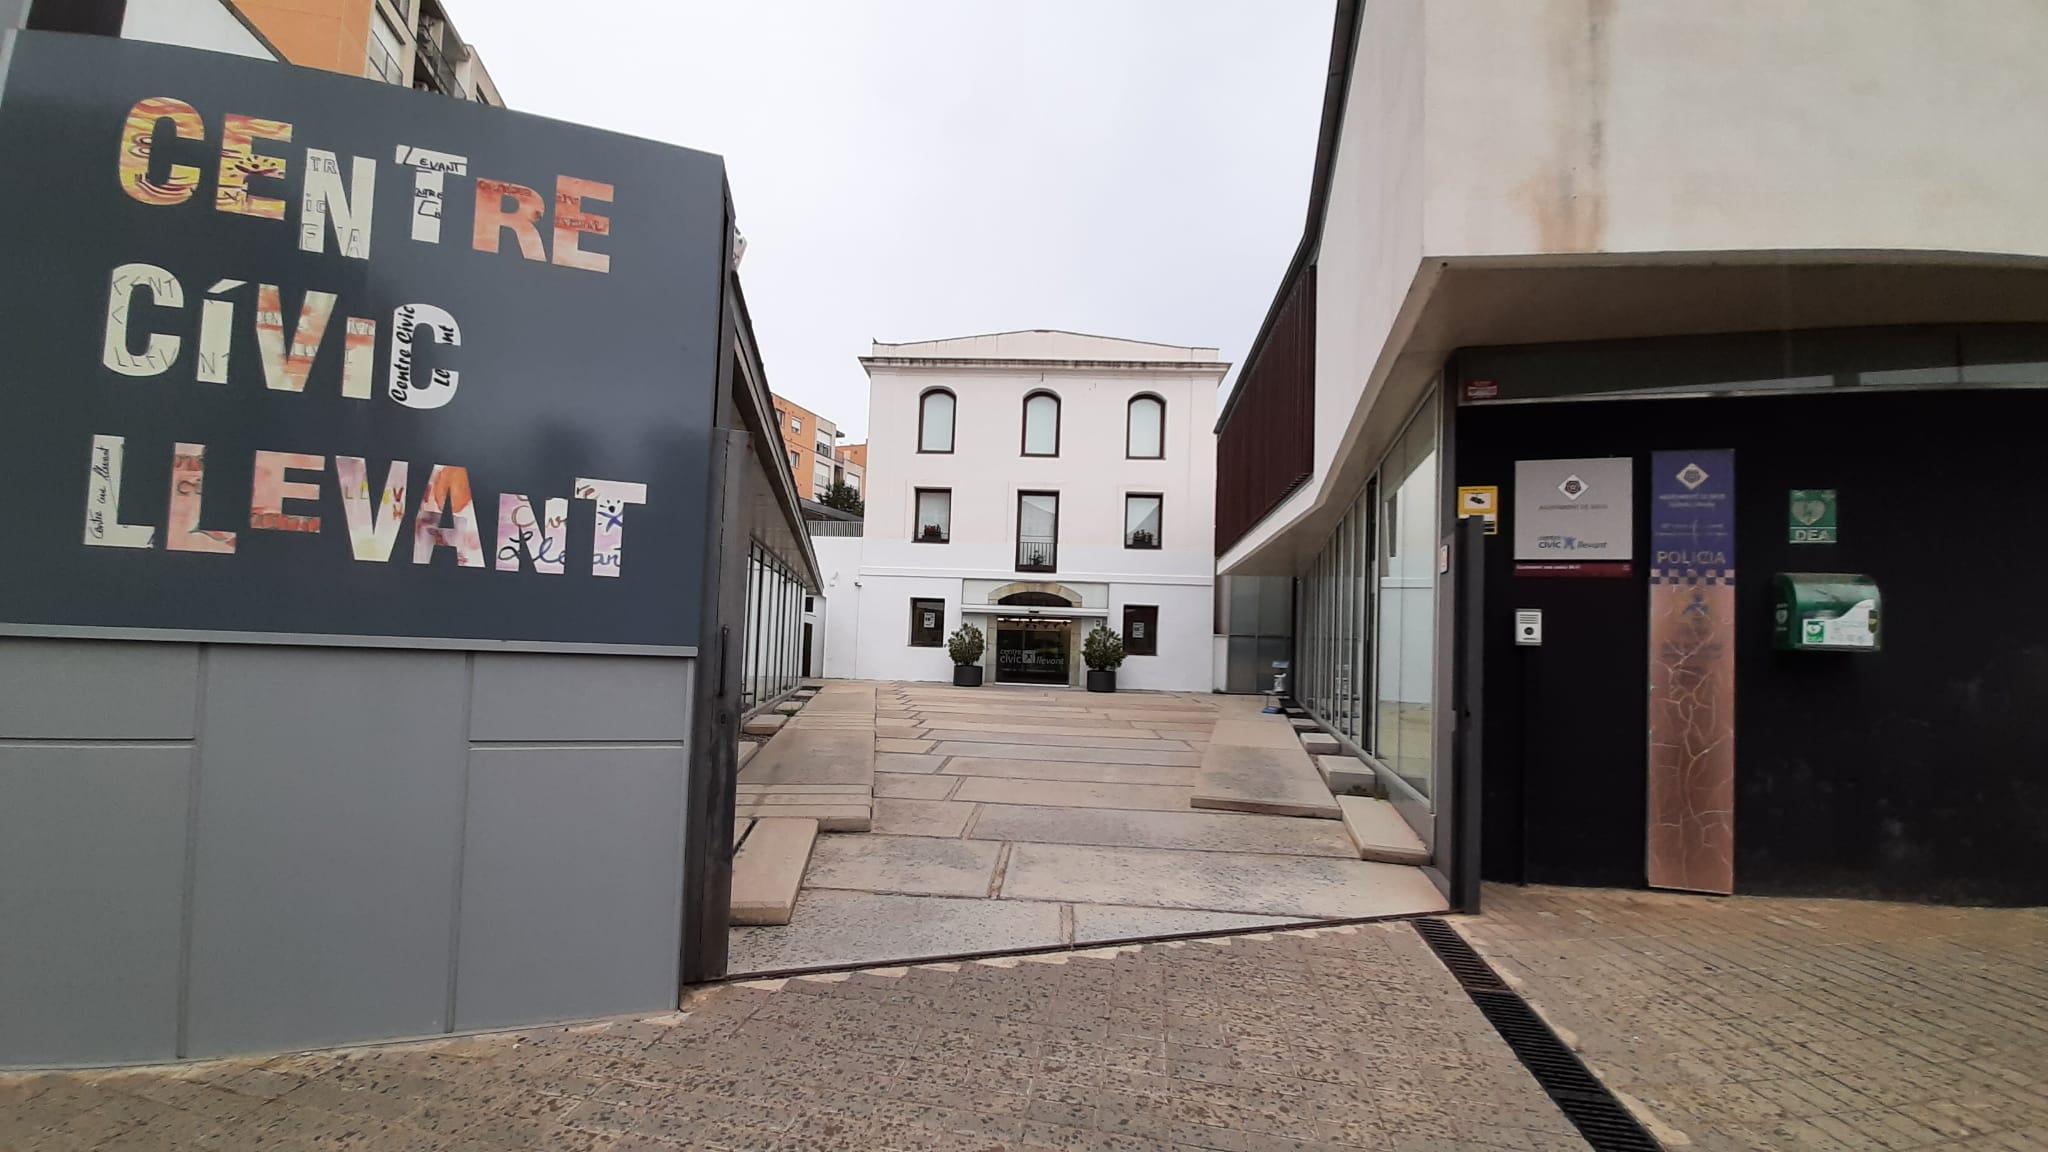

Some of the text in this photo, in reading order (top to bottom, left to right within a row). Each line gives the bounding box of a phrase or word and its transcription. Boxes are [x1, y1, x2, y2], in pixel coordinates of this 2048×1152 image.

[119, 97, 614, 273] CENTRE
[84, 434, 647, 577] LLEVANT
[1795, 529, 1830, 541] DEA
